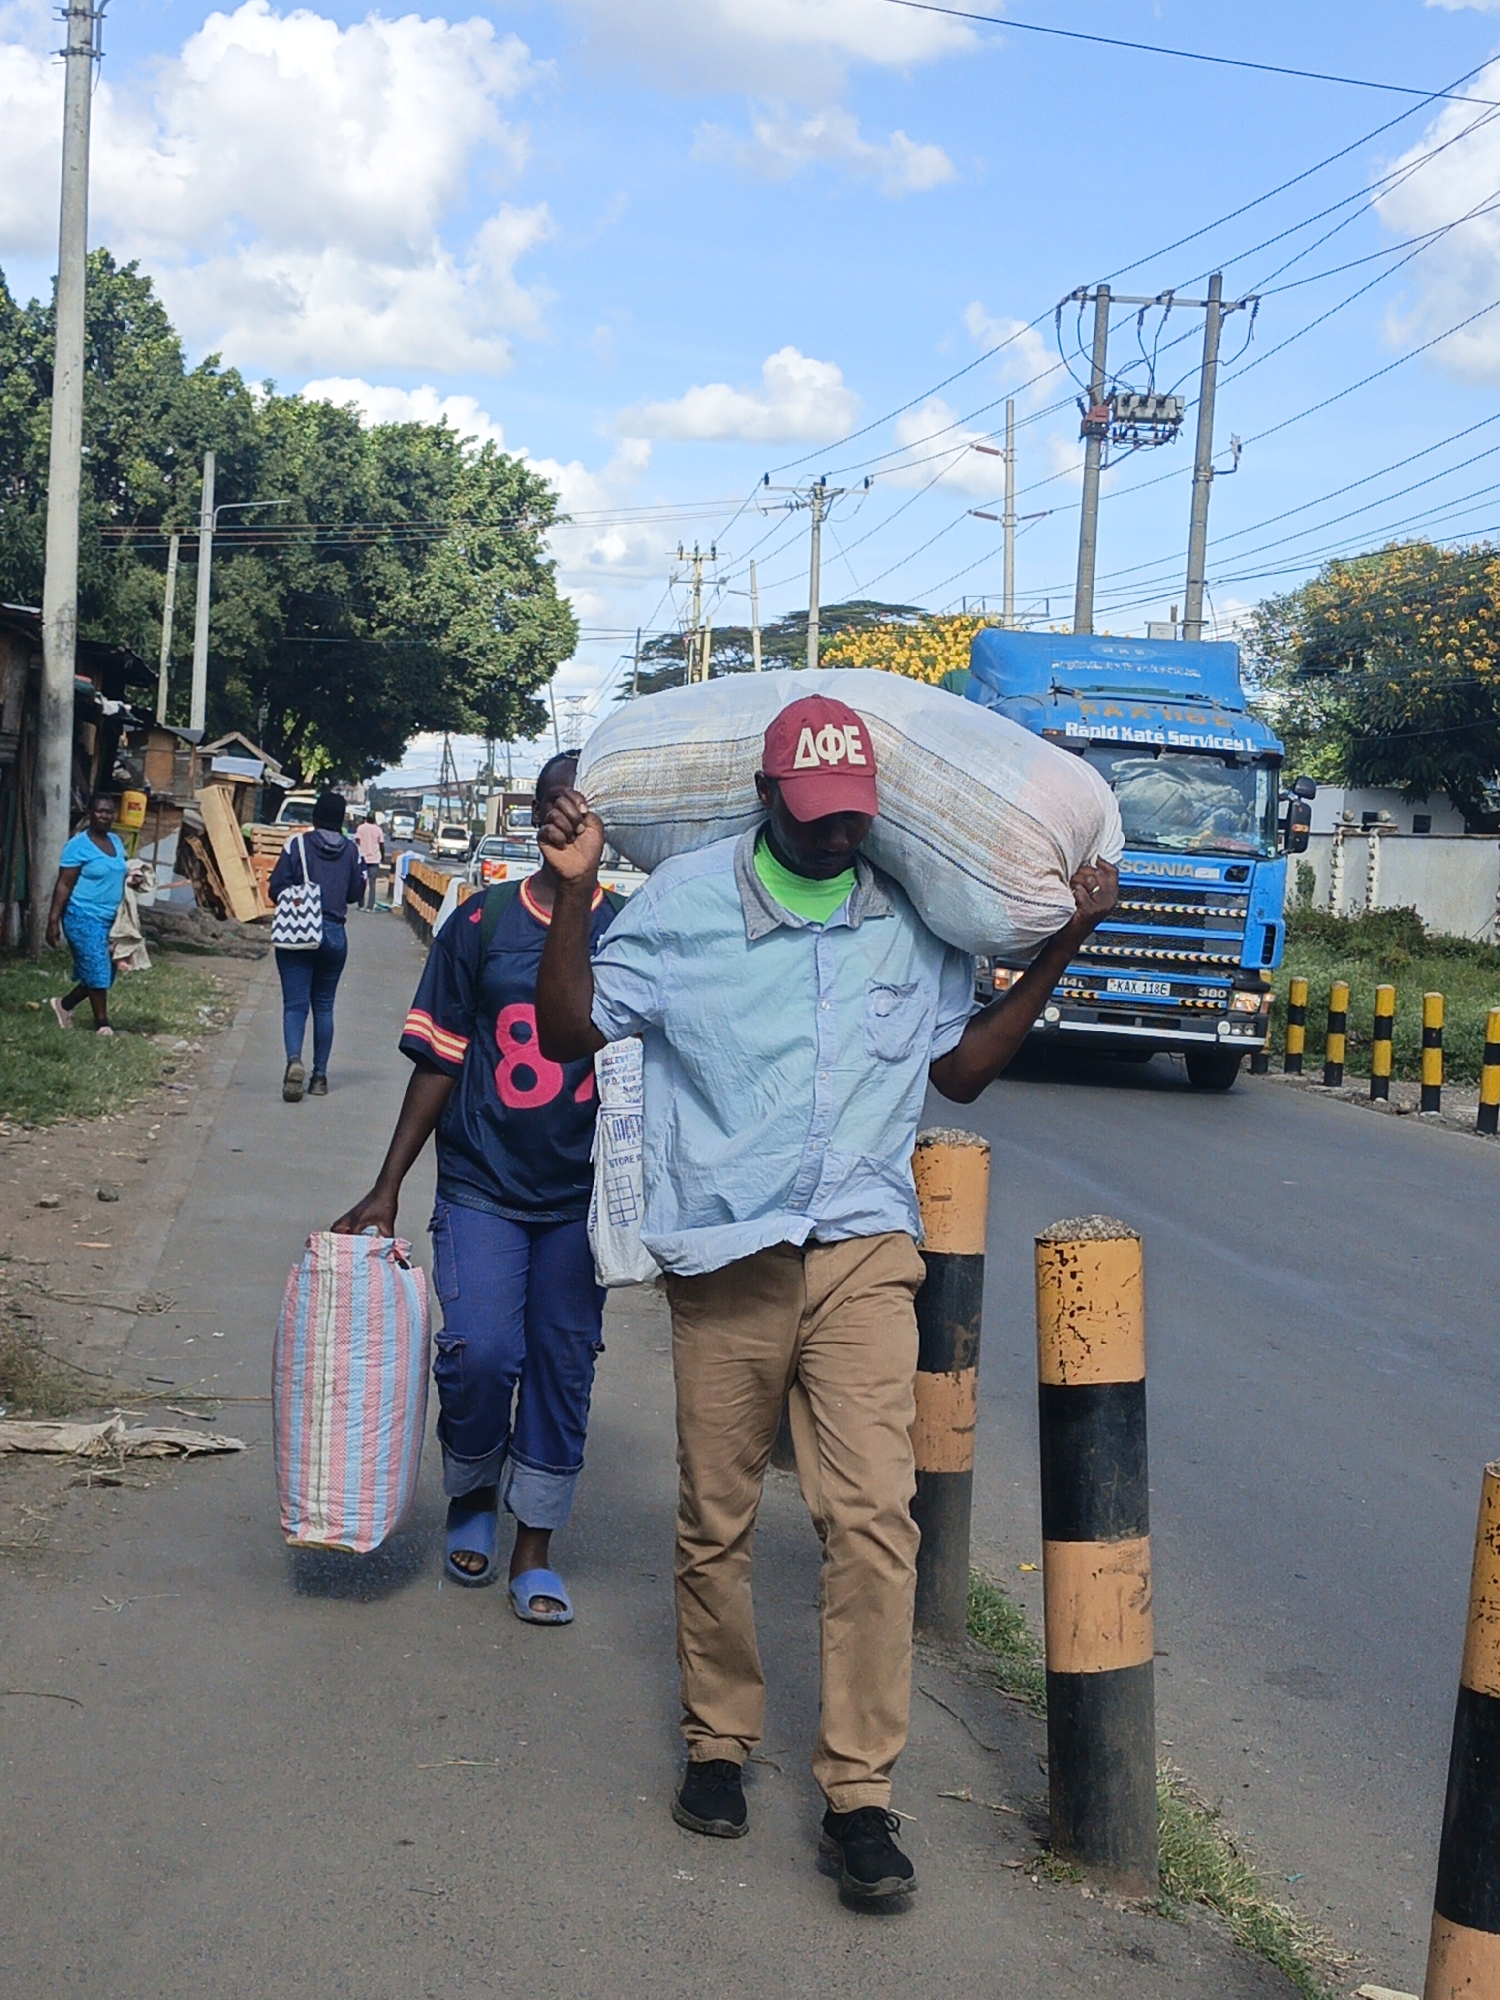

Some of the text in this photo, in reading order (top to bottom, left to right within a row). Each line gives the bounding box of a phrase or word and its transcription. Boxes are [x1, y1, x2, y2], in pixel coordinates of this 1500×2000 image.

[1065, 721, 1118, 741] Rapid
[1121, 726, 1165, 744] Kate
[793, 723, 867, 769] ΔΦΕ
[1119, 860, 1196, 878] SCANIA
[1116, 981, 1168, 995] KAX 118E
[1198, 987, 1227, 999] 380
[495, 1003, 594, 1109] 8
[609, 1155, 635, 1168] STORE
